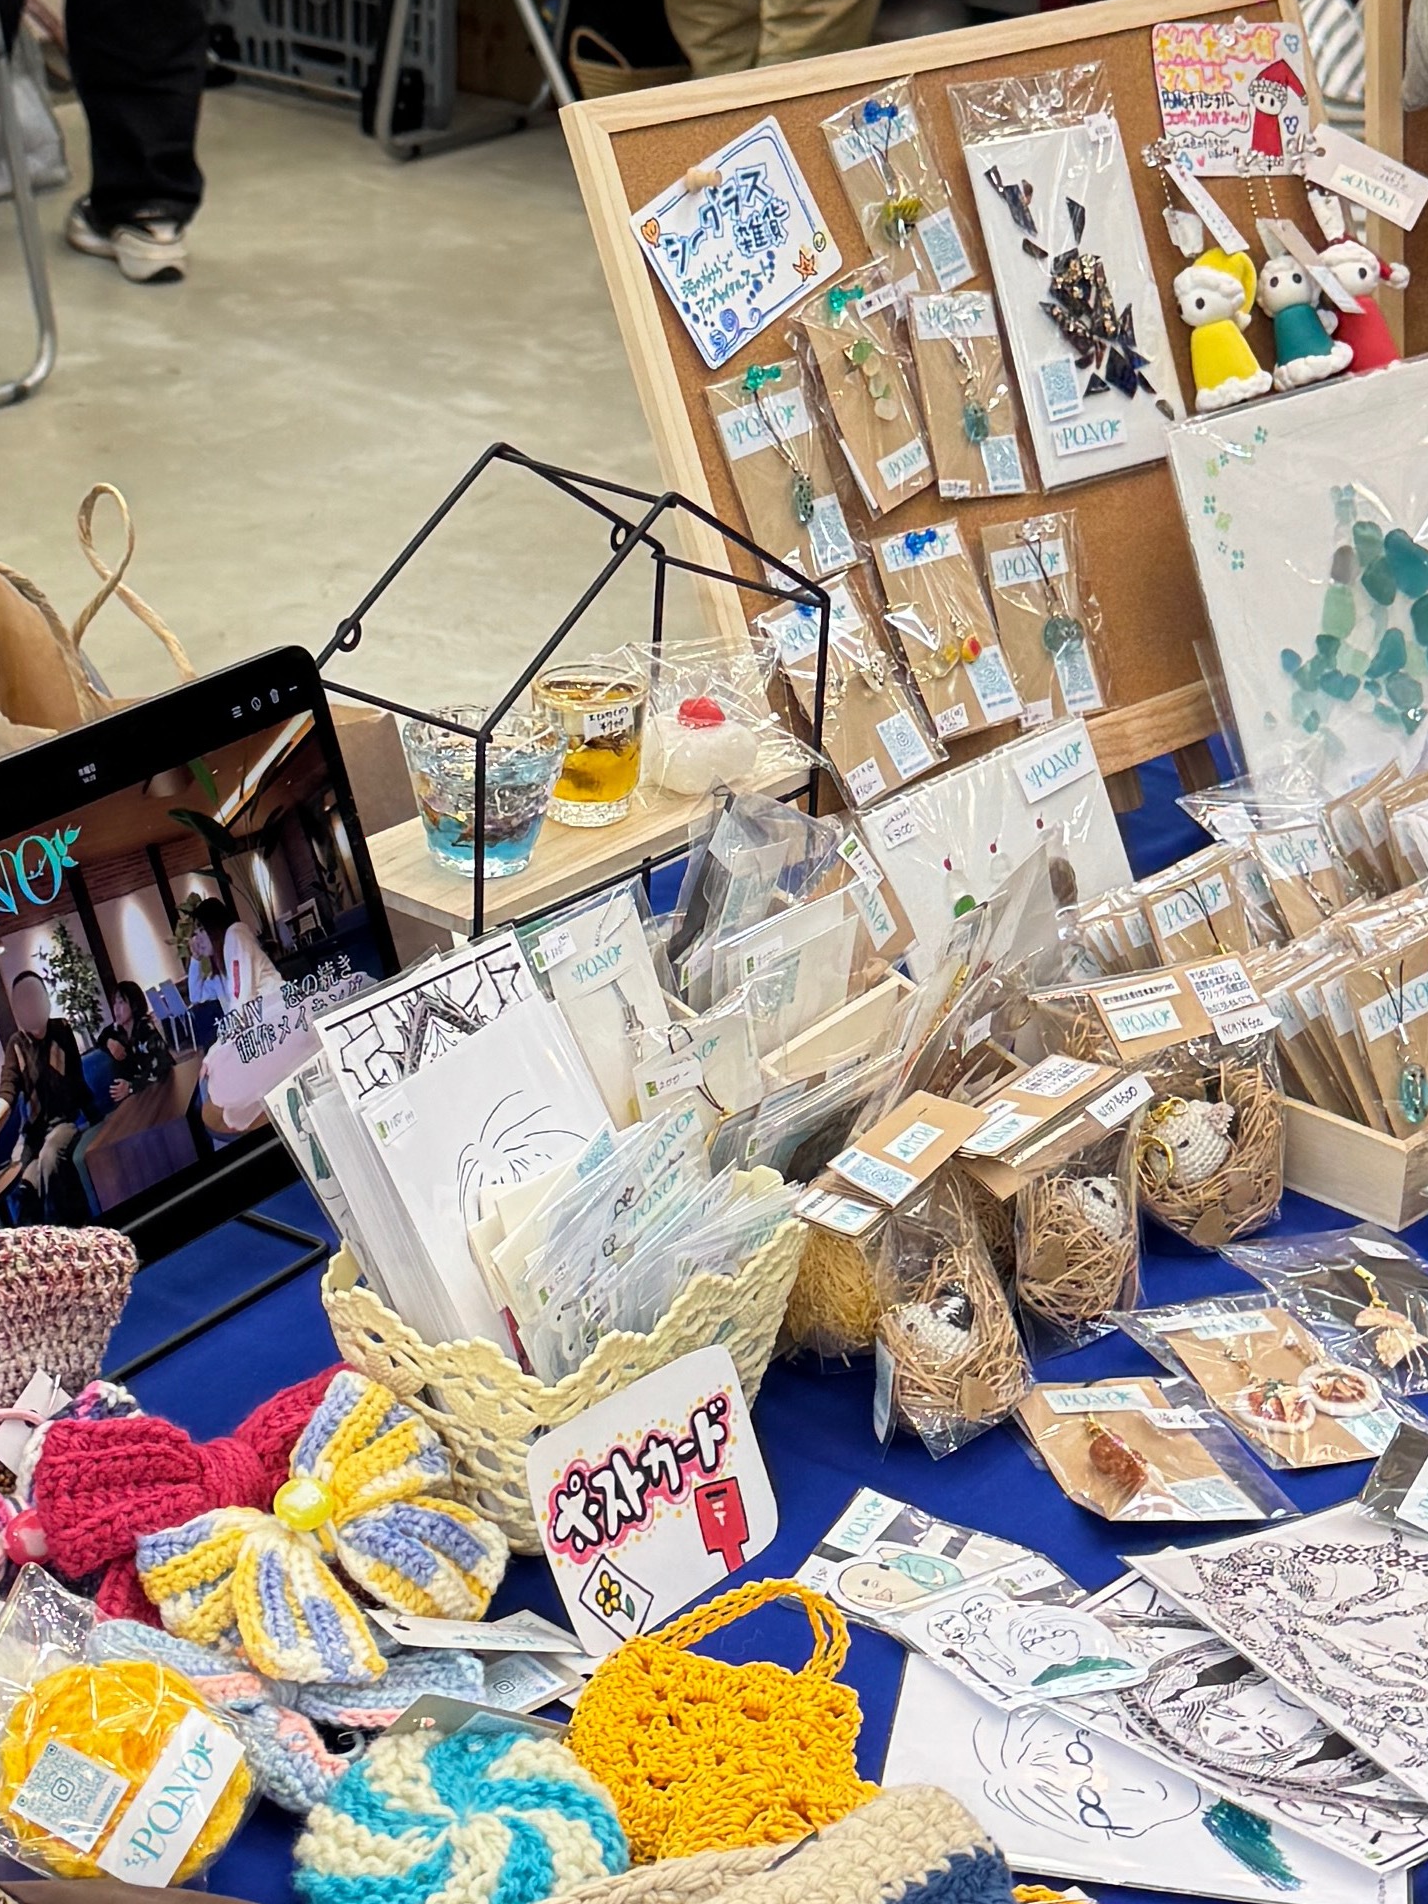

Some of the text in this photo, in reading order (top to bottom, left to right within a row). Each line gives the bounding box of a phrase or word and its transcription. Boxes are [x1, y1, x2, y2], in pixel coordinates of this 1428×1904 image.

[1340, 173, 1401, 210] PONO
[658, 164, 776, 278] シーグラス
[733, 192, 791, 260] 雑貨
[887, 442, 924, 480] PONO
[1057, 420, 1122, 452] PONO
[1025, 742, 1084, 790] PONO
[279, 953, 354, 1010] 恋の続き
[573, 945, 624, 984] PONO
[1113, 1006, 1175, 1038] PONO
[642, 1107, 697, 1185] PONO
[1054, 1389, 1133, 1409] PONO
[552, 1396, 729, 1554] ポストカード
[839, 1496, 886, 1549] PONO
[124, 1731, 216, 1870] PONO
